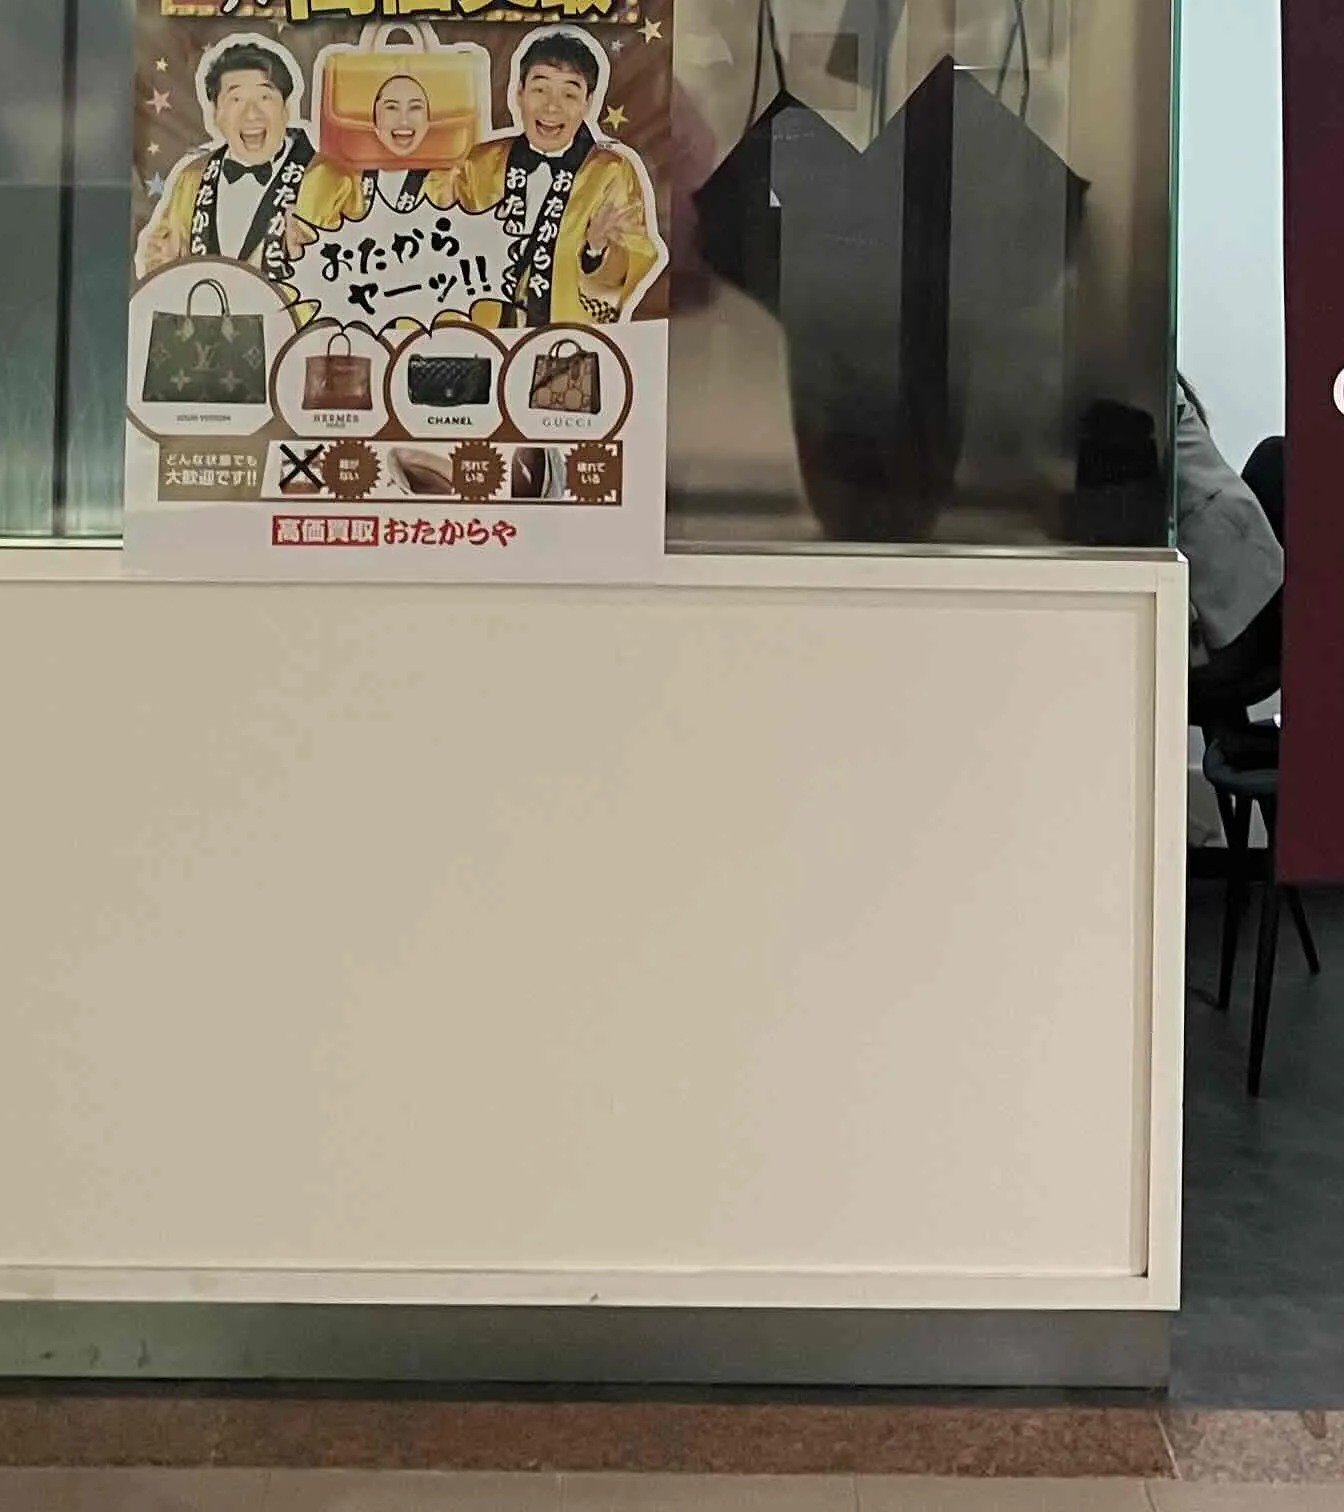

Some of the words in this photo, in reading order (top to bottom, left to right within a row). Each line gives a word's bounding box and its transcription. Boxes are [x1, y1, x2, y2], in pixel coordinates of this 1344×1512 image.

[528, 168, 574, 299] おたからや
[320, 217, 460, 282] おたから
[427, 415, 473, 426] CHANEL
[542, 416, 592, 428] GUCCI
[275, 517, 377, 544] 高価買取
[383, 518, 518, 548] おたからや
